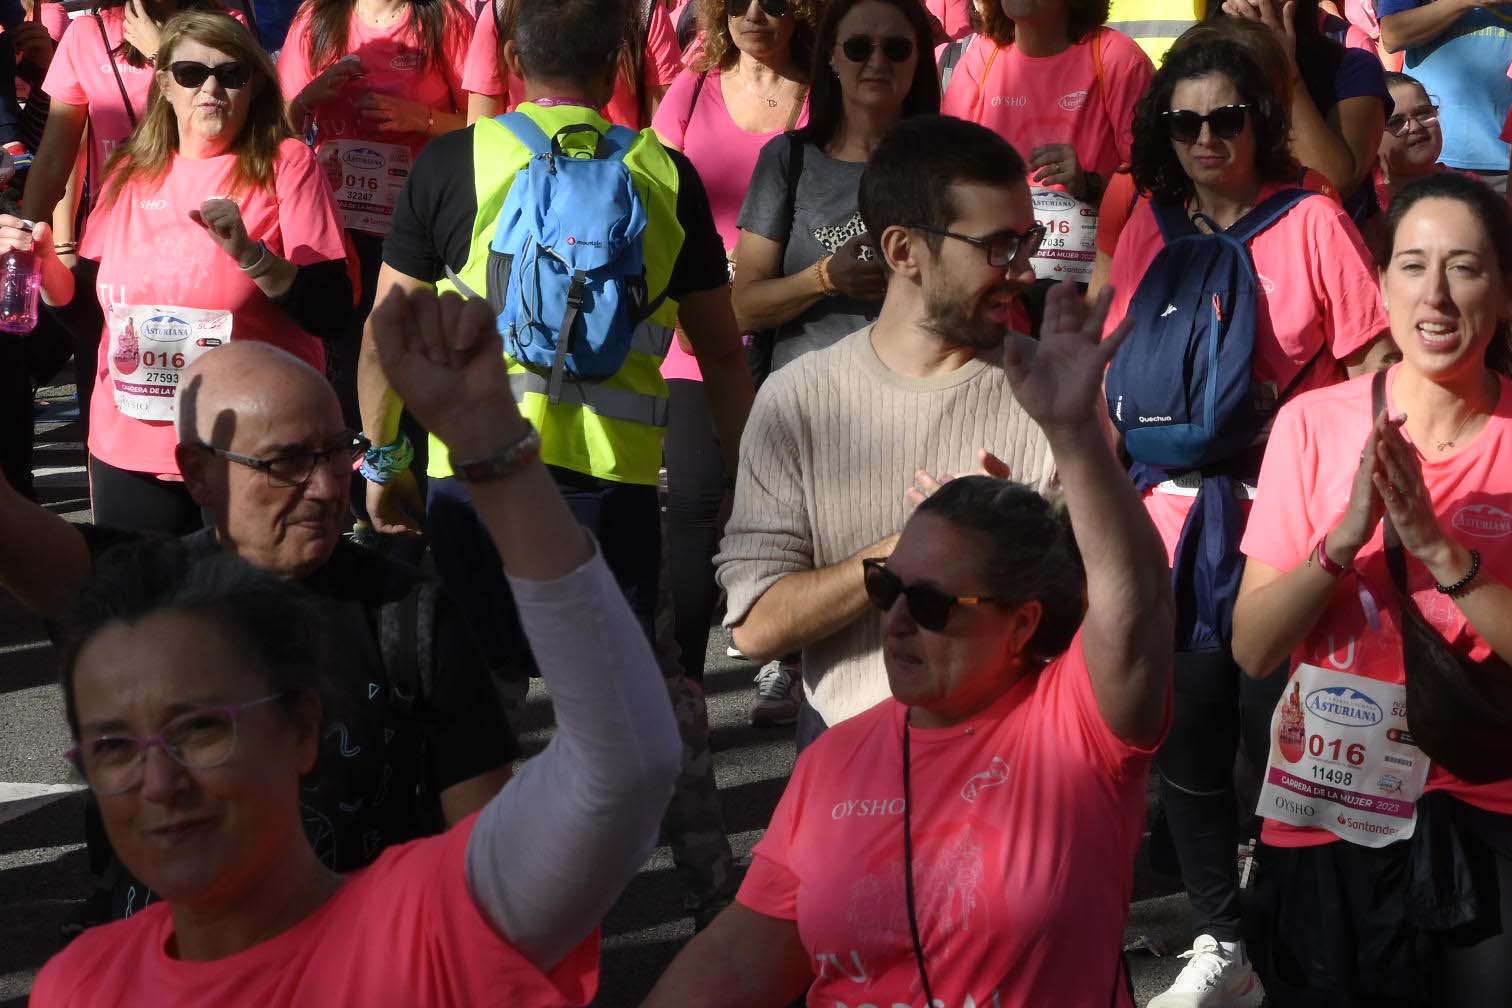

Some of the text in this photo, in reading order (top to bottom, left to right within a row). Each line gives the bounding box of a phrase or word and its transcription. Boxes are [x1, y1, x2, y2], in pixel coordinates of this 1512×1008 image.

[345, 175, 378, 190] 016
[145, 324, 189, 337] ASTURIANA
[142, 351, 186, 369] 016
[146, 372, 180, 384] 27593
[149, 385, 160, 394] DE
[160, 386, 171, 395] LA
[1138, 415, 1172, 423] Quechua
[1310, 695, 1377, 723] ASTURIANA
[1309, 734, 1367, 766] 016
[1311, 764, 1353, 786] 11498
[1281, 775, 1400, 813] CARRERA DE LA MUJER 2023
[831, 798, 906, 821] OYSHO
[1275, 795, 1315, 817] OYSHO
